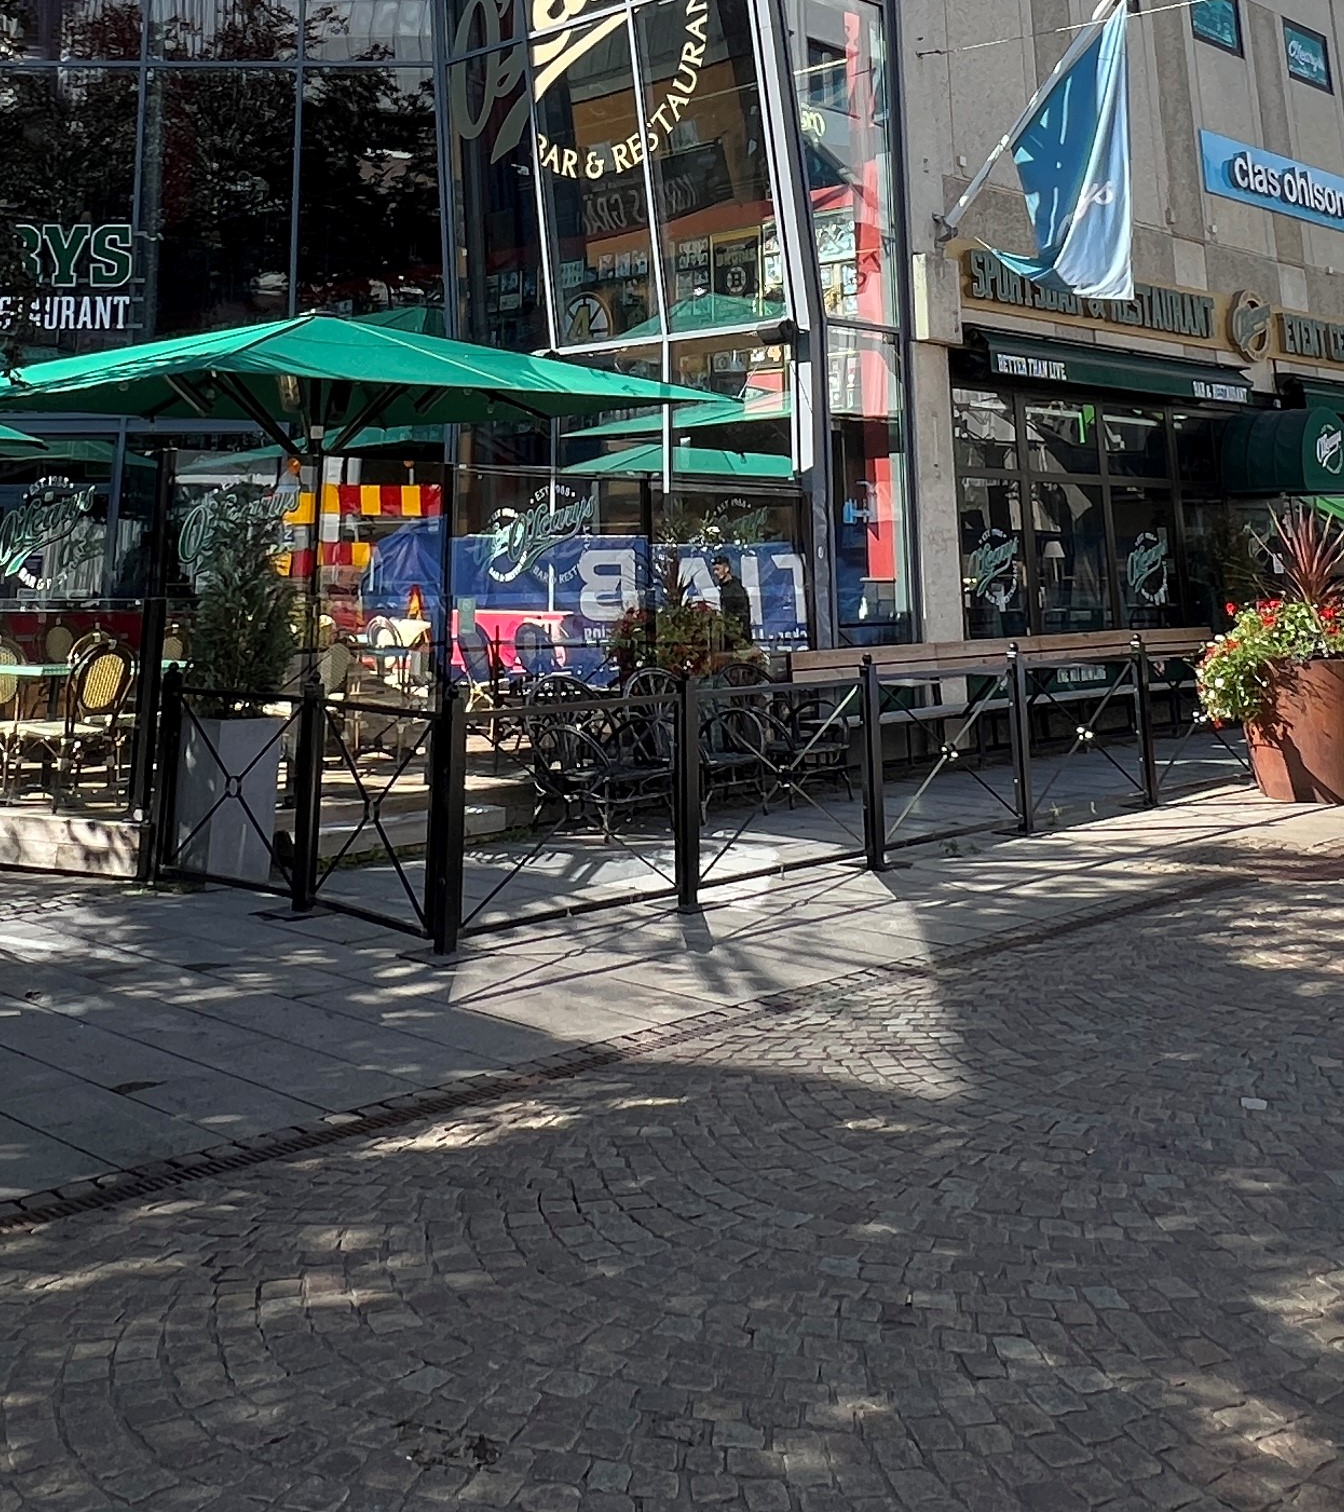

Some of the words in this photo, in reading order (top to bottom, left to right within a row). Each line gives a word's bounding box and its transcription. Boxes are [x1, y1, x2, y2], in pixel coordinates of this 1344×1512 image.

[535, 132, 578, 179] BAR
[586, 151, 605, 180] &
[1233, 150, 1282, 198] clas
[1283, 313, 1327, 359] EVENT
